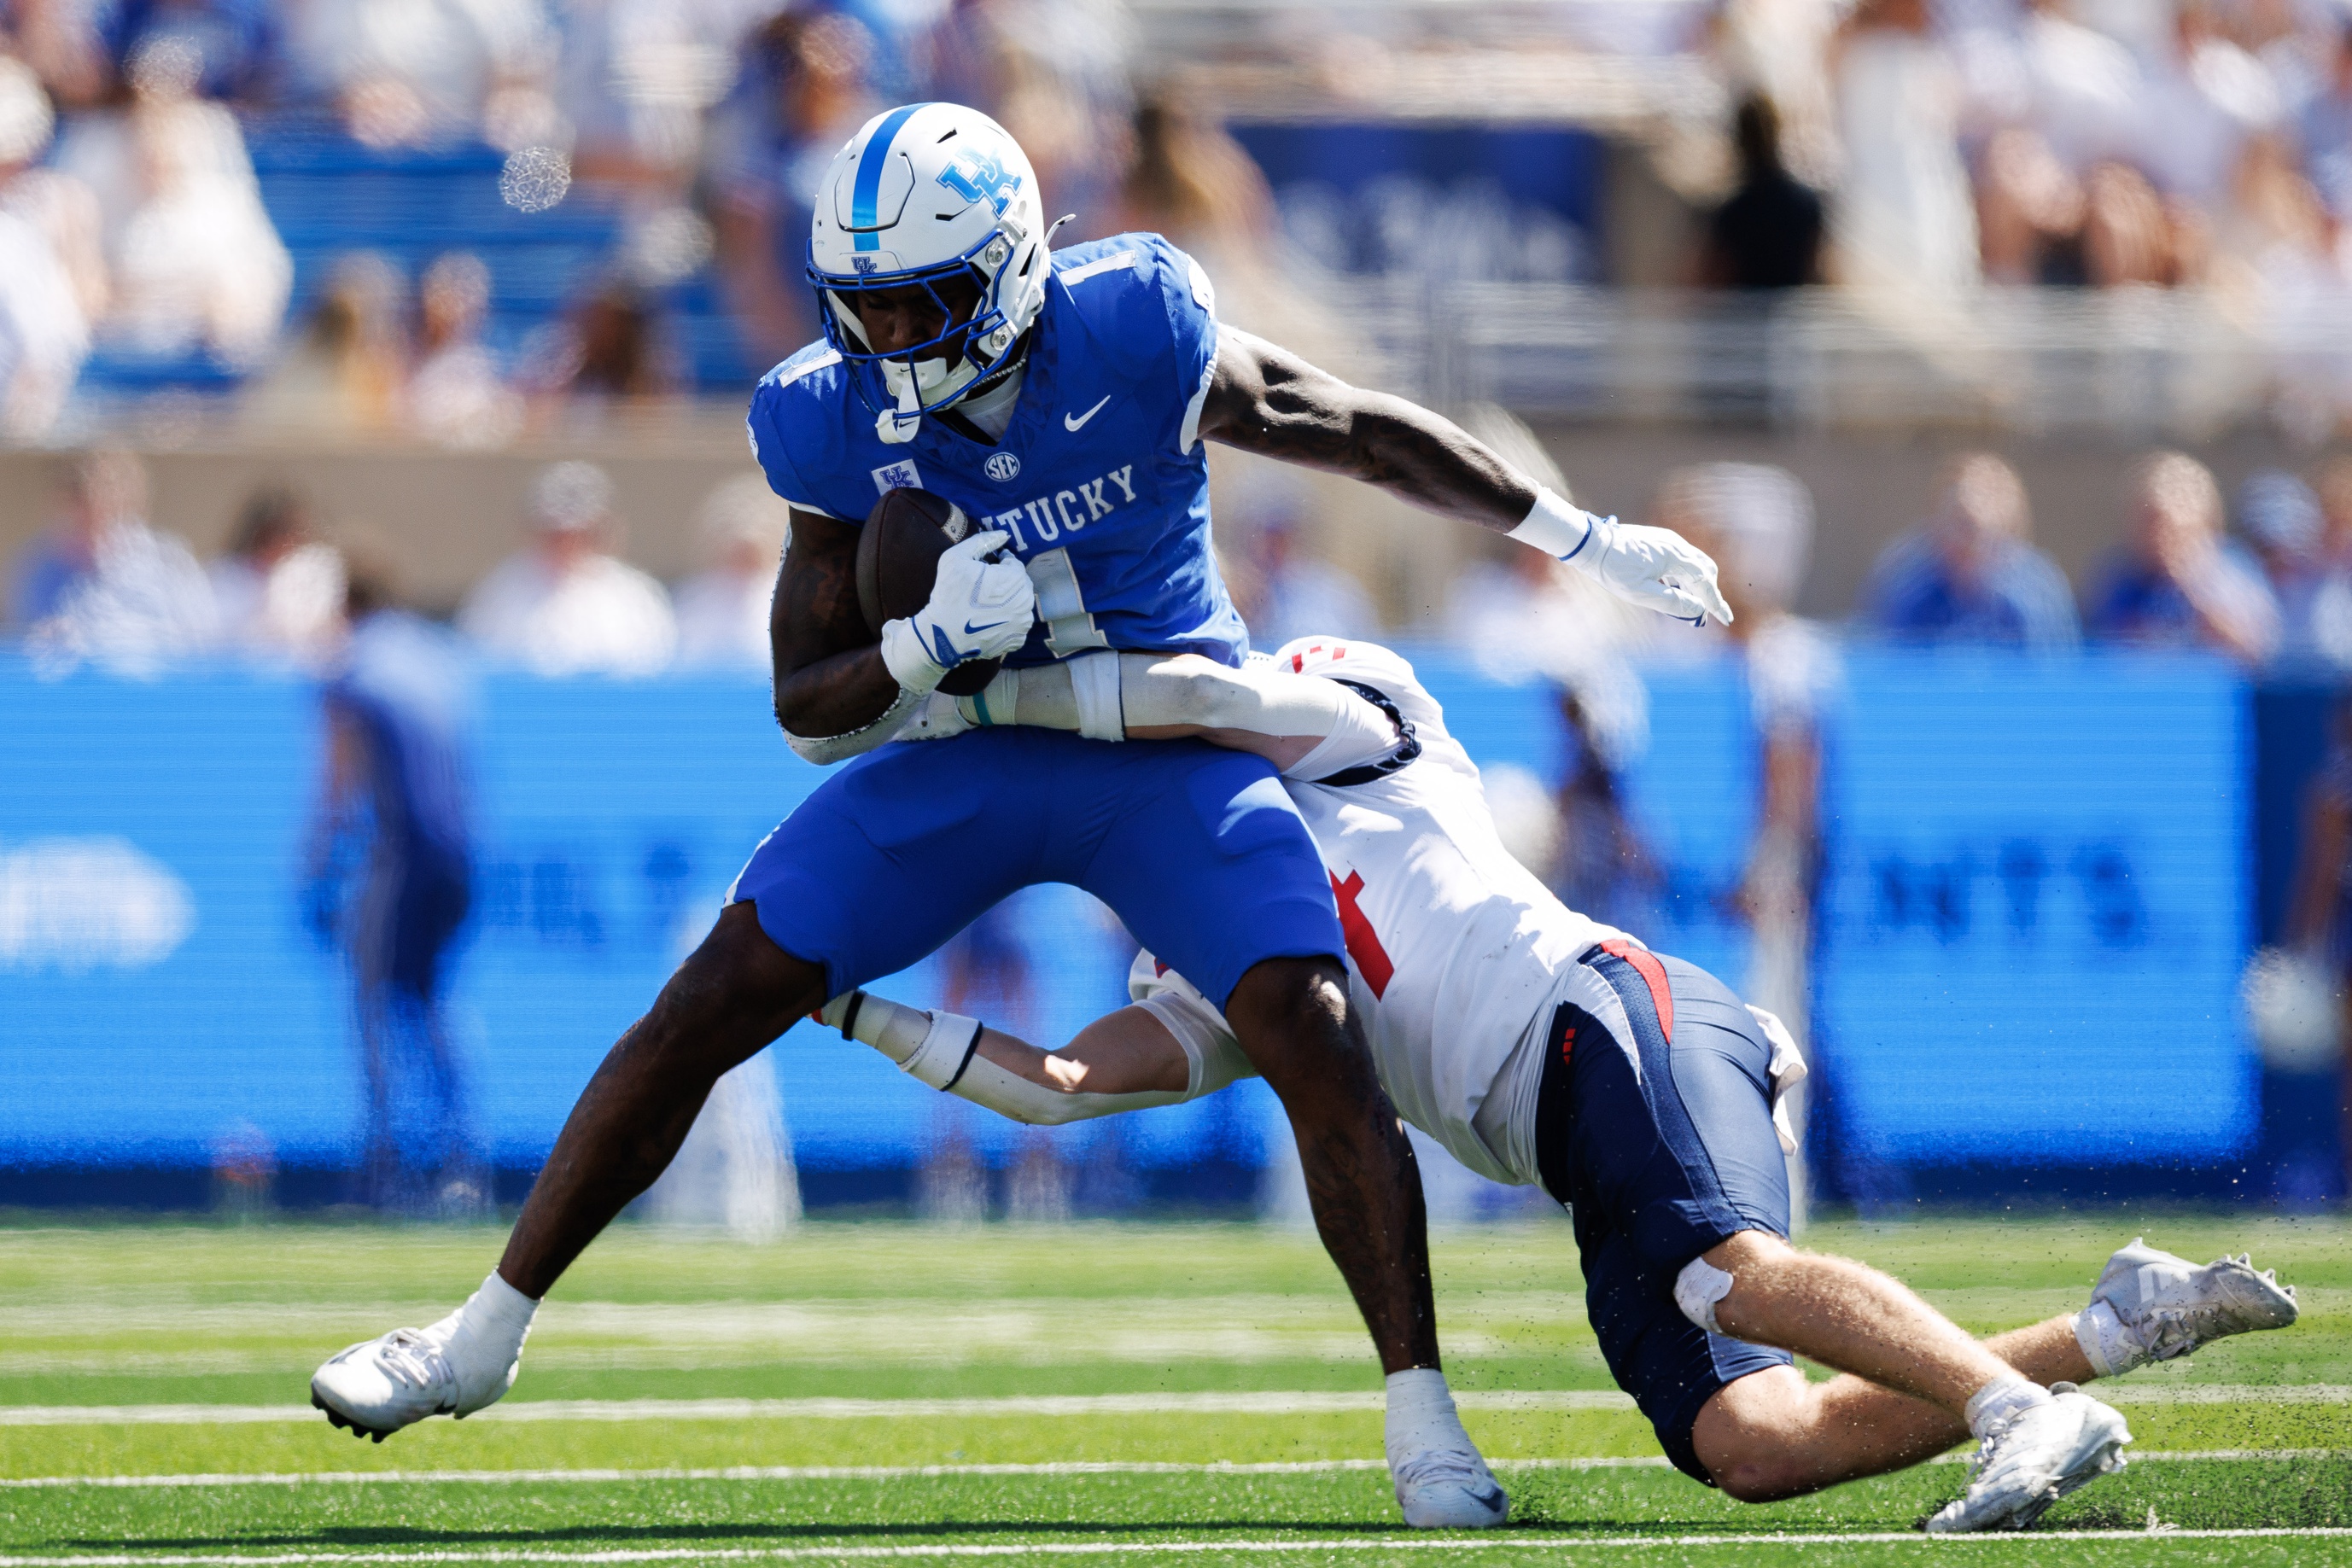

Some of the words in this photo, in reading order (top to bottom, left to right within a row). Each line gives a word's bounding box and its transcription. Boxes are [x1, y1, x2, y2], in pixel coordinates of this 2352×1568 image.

[936, 147, 1023, 220] UK
[879, 466, 913, 489] UK
[988, 454, 1017, 480] SEC
[979, 464, 1136, 552] TUCKY
